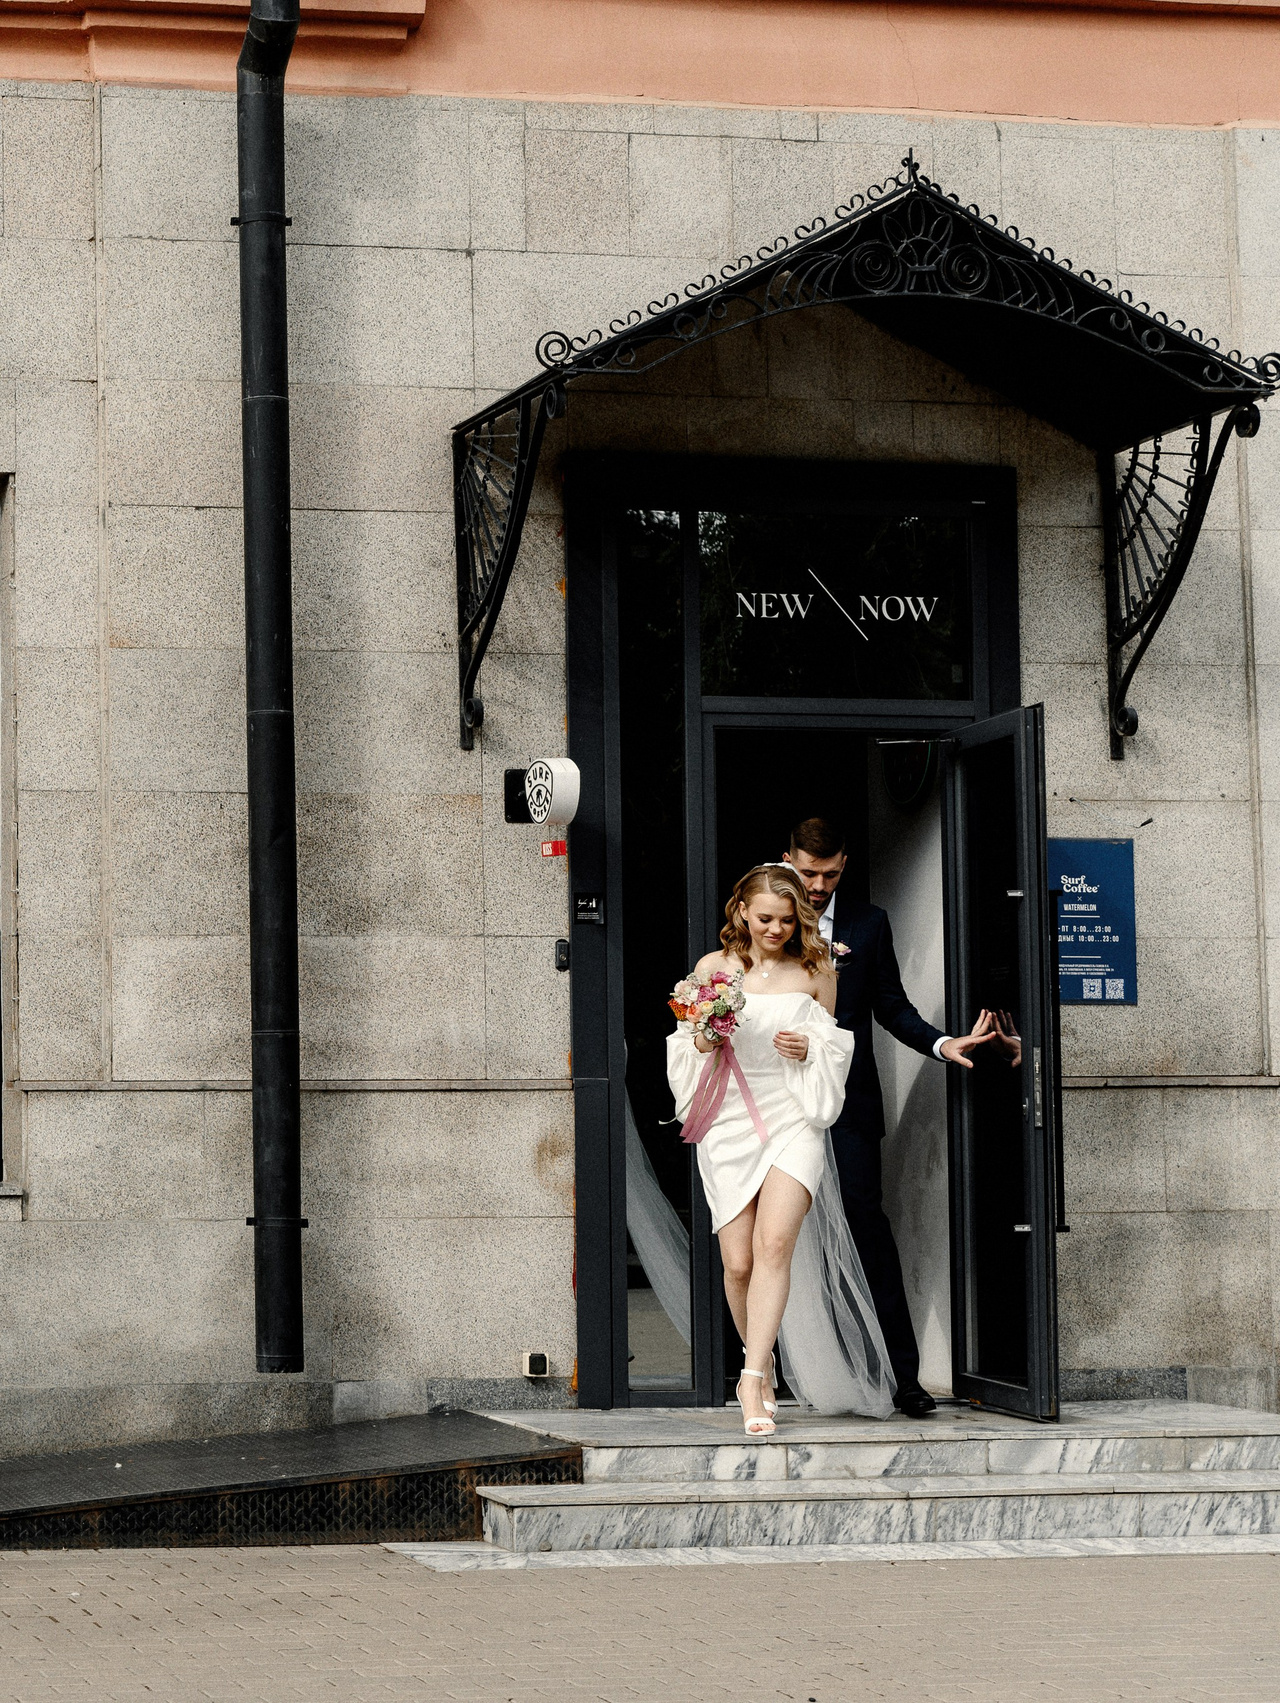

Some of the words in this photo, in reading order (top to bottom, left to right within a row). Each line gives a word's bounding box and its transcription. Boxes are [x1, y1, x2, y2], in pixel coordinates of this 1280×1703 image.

[736, 592, 814, 619] NEW
[859, 595, 939, 622] NOW
[527, 766, 550, 788] SURF
[529, 794, 550, 817] COFFEE
[1060, 874, 1086, 885] Surf
[1063, 883, 1098, 893] Coffee
[1063, 903, 1097, 912] WATERMELON
